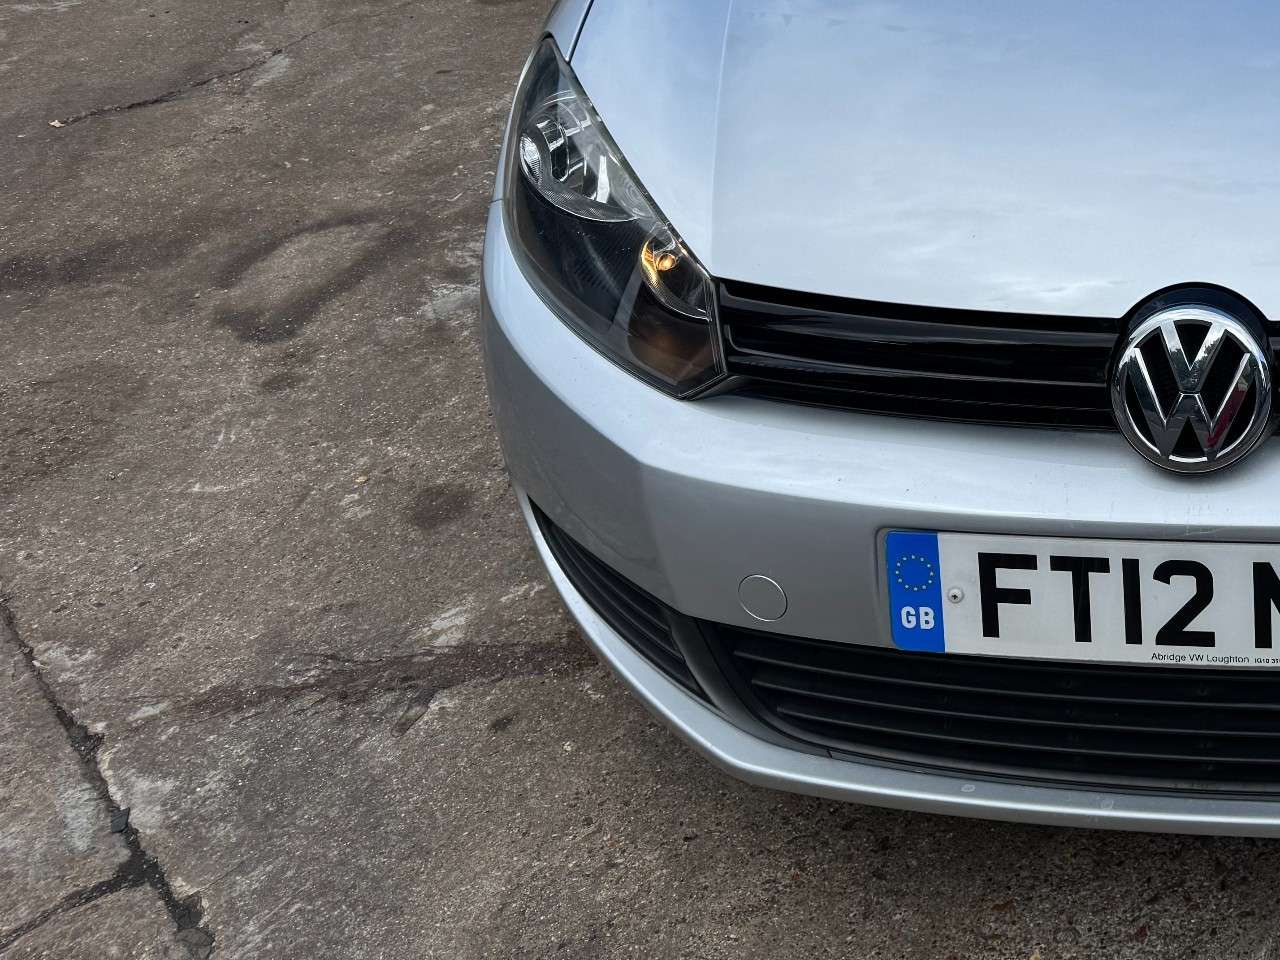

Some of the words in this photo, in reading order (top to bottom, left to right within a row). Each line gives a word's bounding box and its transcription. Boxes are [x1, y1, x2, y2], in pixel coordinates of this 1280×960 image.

[976, 550, 1216, 648] FT12
[900, 606, 935, 630] GB
[1151, 652, 1187, 663] Abridge
[1188, 653, 1204, 662] VW
[1206, 653, 1250, 664] Loughton
